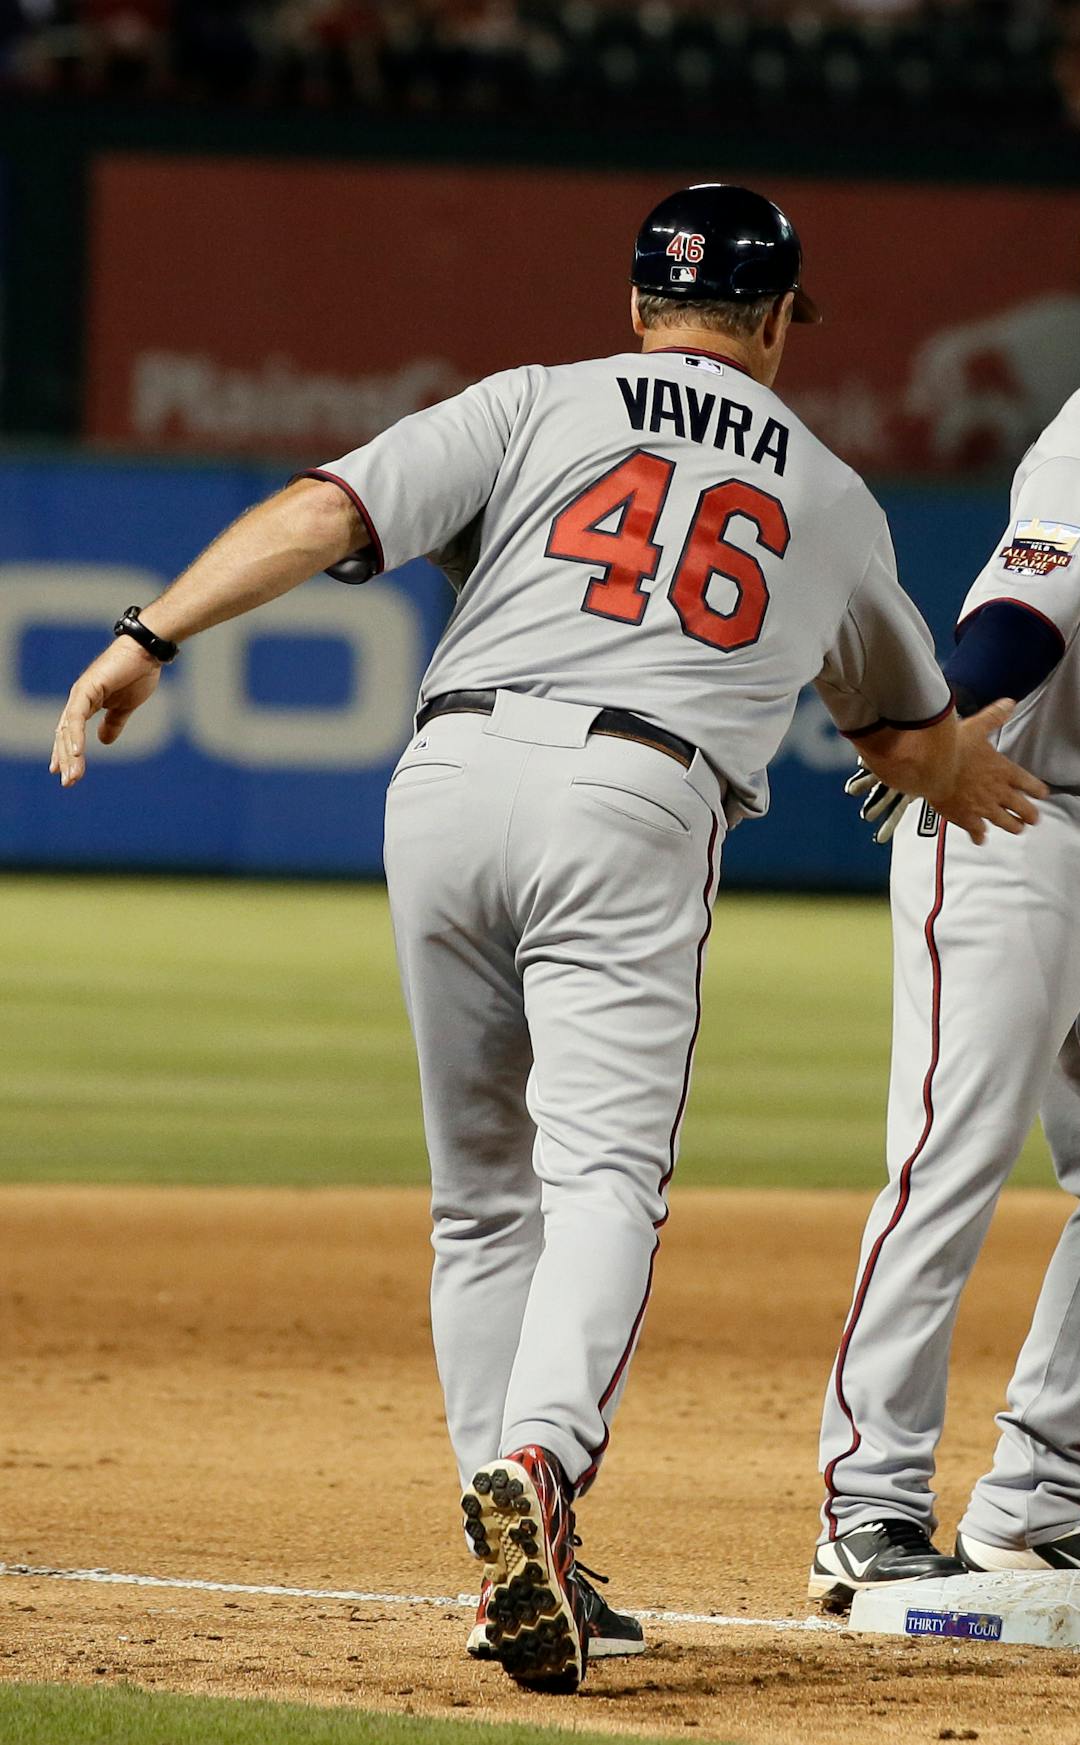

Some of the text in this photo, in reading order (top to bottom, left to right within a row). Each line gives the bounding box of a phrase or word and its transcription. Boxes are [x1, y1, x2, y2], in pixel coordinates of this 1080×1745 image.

[666, 231, 706, 263] 46
[616, 376, 790, 477] VAVRA
[543, 448, 792, 654] 46
[1003, 548, 1068, 566] ALL STAR
[1011, 558, 1048, 571] GAME
[907, 1617, 998, 1637] THIRTY TOUR
